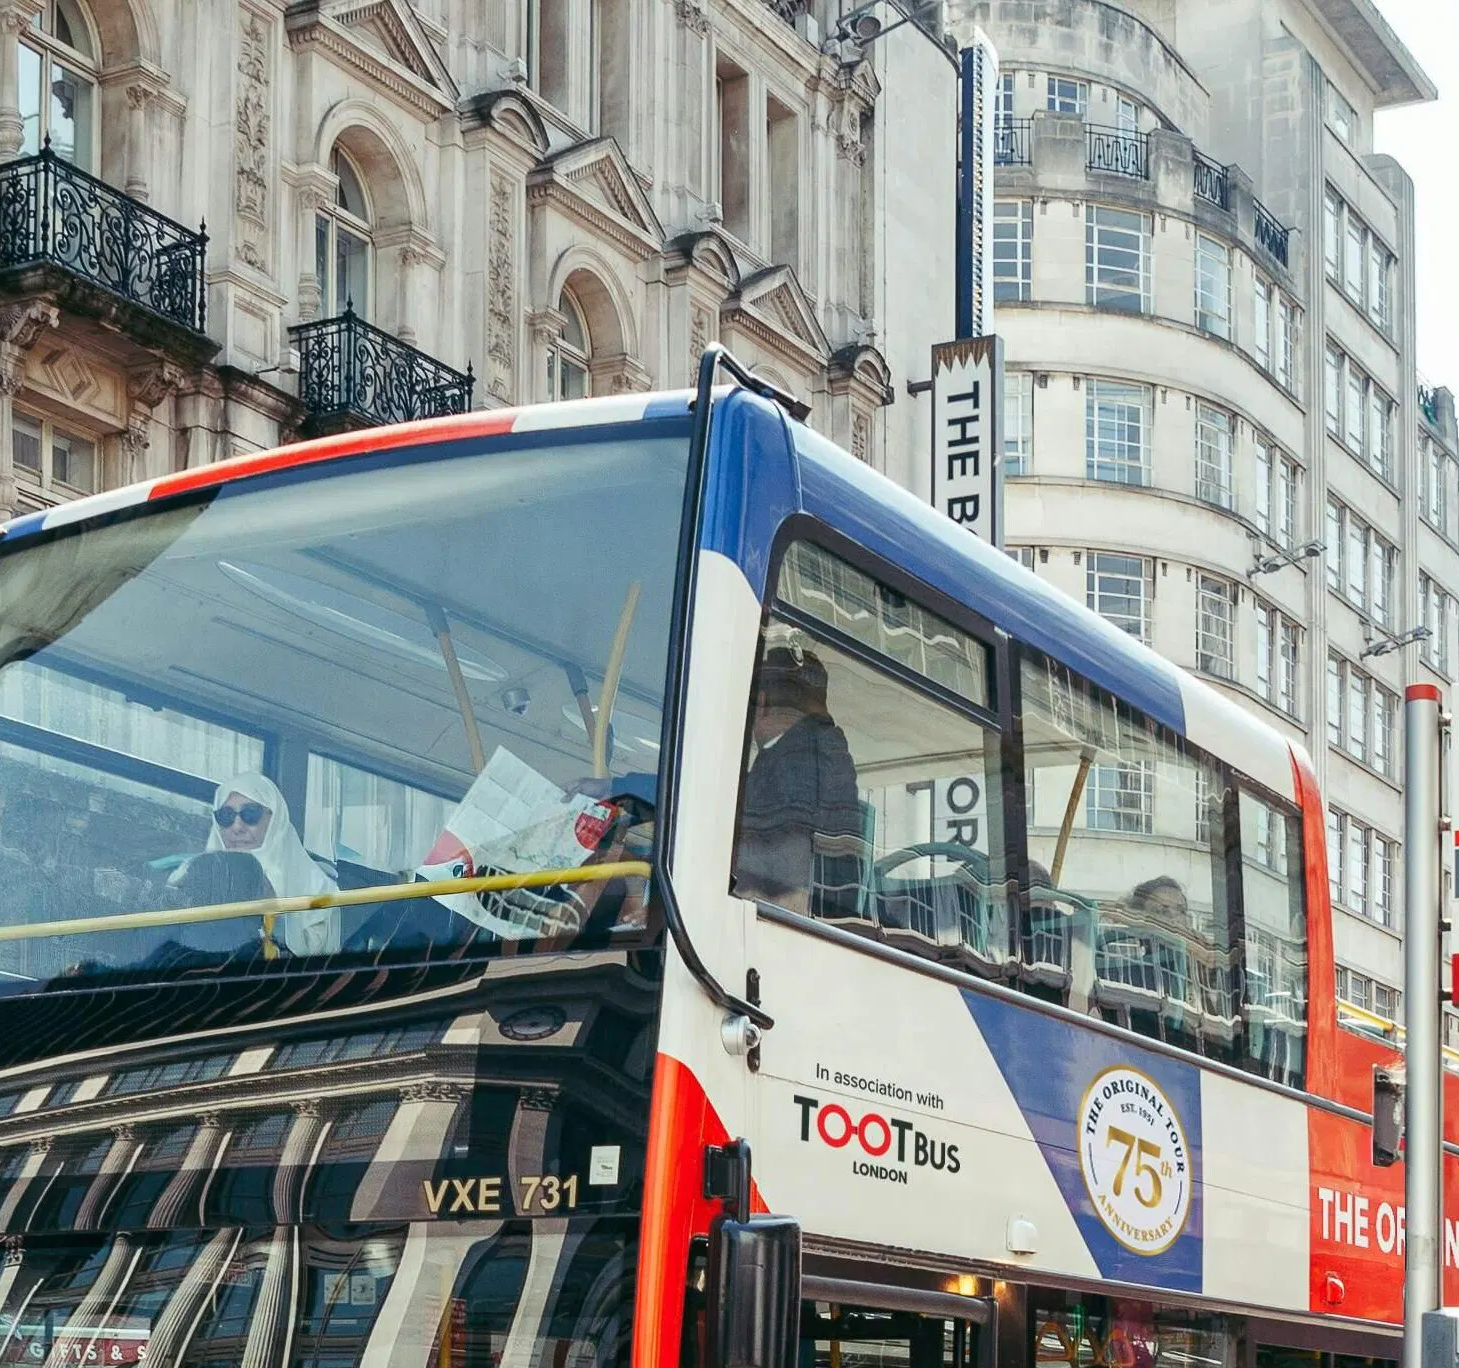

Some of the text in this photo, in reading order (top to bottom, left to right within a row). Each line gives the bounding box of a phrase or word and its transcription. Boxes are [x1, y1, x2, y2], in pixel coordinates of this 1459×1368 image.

[947, 381, 980, 480] THE
[816, 1063, 944, 1110] In association with
[1120, 1103, 1137, 1114] EST.
[1086, 1079, 1184, 1173] THE ORIGINAL TOUR
[423, 1175, 577, 1213] VXE 731
[853, 1161, 908, 1184] LONDON
[1098, 1193, 1173, 1242] ANNIVERSARY
[1318, 1186, 1369, 1248] THE
[111, 1344, 124, 1361] &
